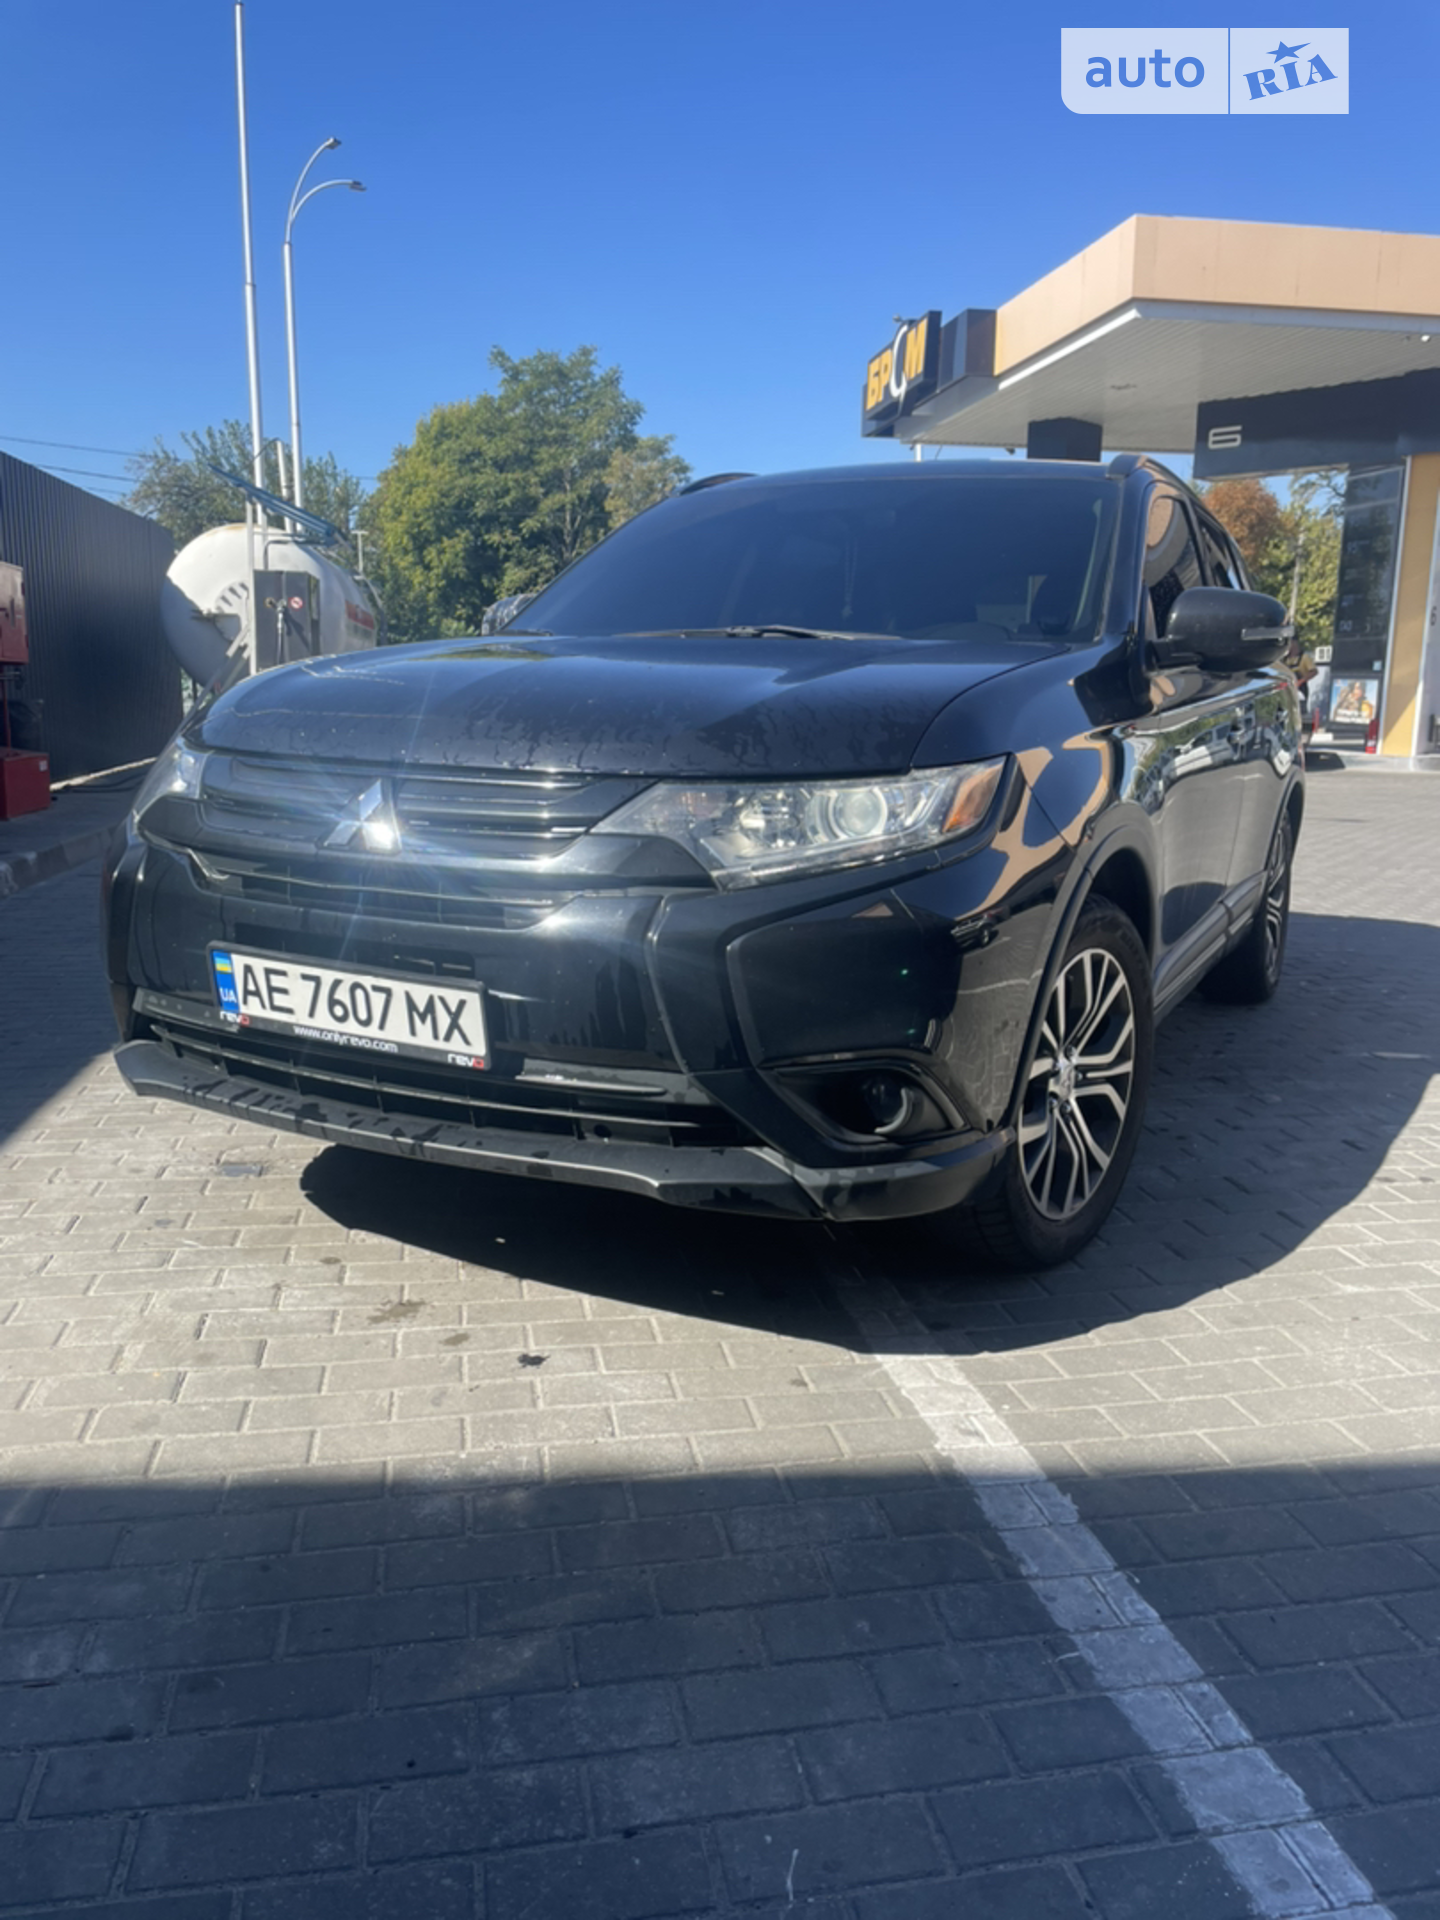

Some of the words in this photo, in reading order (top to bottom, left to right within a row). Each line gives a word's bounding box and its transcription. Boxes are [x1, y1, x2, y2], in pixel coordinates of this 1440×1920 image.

[219, 987, 237, 1003] UA
[242, 963, 295, 1015] AE
[300, 973, 393, 1031] 7607
[405, 989, 472, 1046] MX
